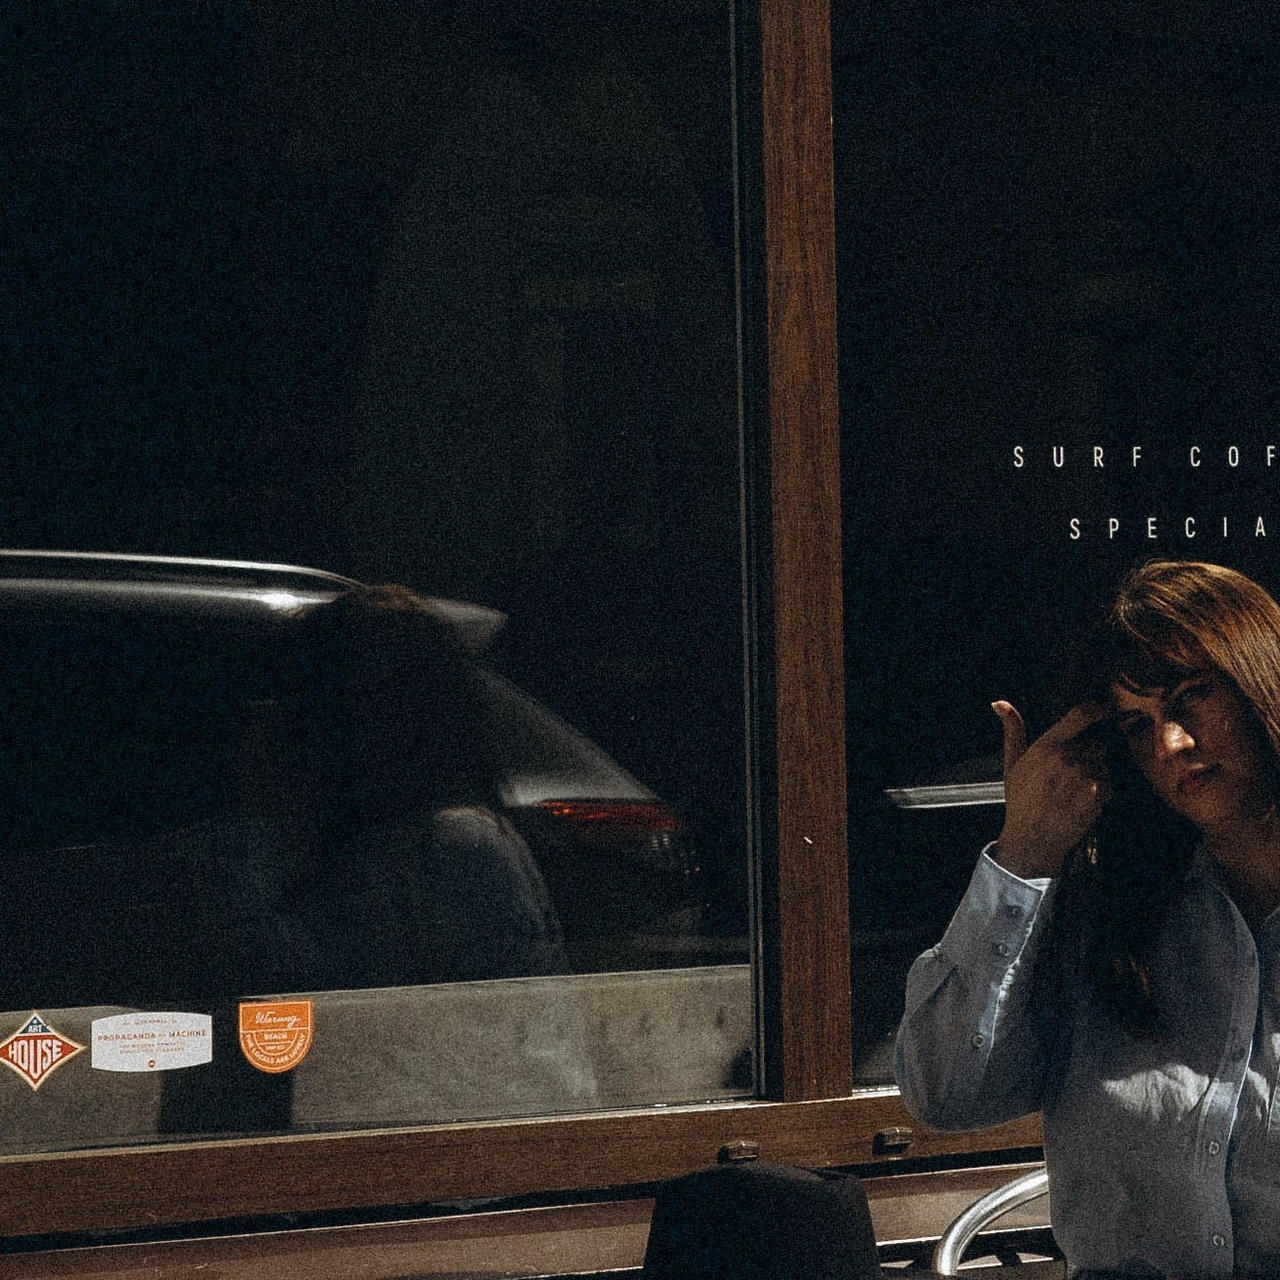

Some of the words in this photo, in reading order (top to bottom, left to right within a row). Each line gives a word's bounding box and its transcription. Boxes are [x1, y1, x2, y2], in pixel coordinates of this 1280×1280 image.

[1012, 445, 1142, 468] SURF
[28, 1024, 43, 1033] ART
[97, 1032, 156, 1042] PROPAGANDA
[168, 1029, 206, 1039] MACHINE
[8, 1039, 63, 1080] HOUSE
